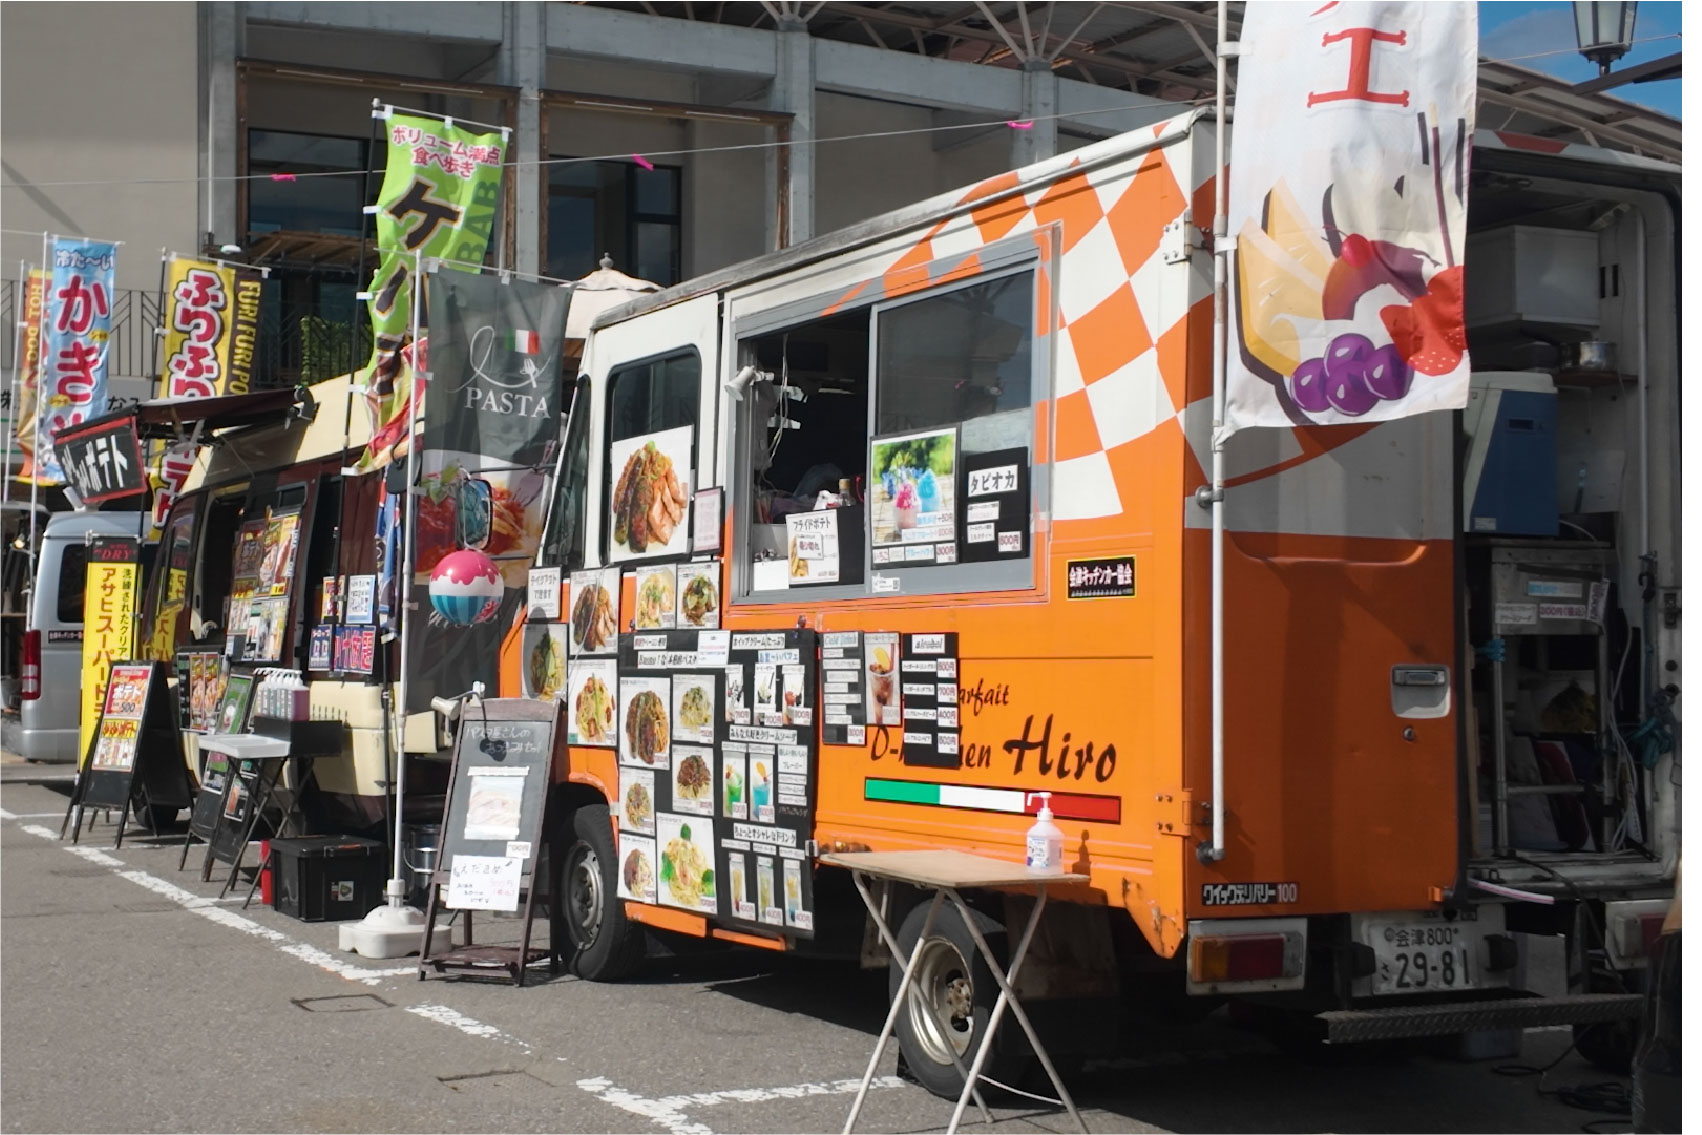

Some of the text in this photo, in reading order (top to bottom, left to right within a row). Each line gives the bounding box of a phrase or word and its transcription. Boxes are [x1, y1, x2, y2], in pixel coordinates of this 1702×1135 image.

[413, 147, 475, 178] 食べ歩き
[238, 280, 261, 323] FURI
[234, 323, 256, 369] FURI
[464, 387, 551, 419] PASTA
[970, 470, 1015, 493] タピオカ
[958, 678, 1010, 717] arfait
[1002, 713, 1117, 783] Hiro
[1203, 883, 1297, 905] クイックデリバリー 100
[1395, 949, 1470, 988] 29-81
